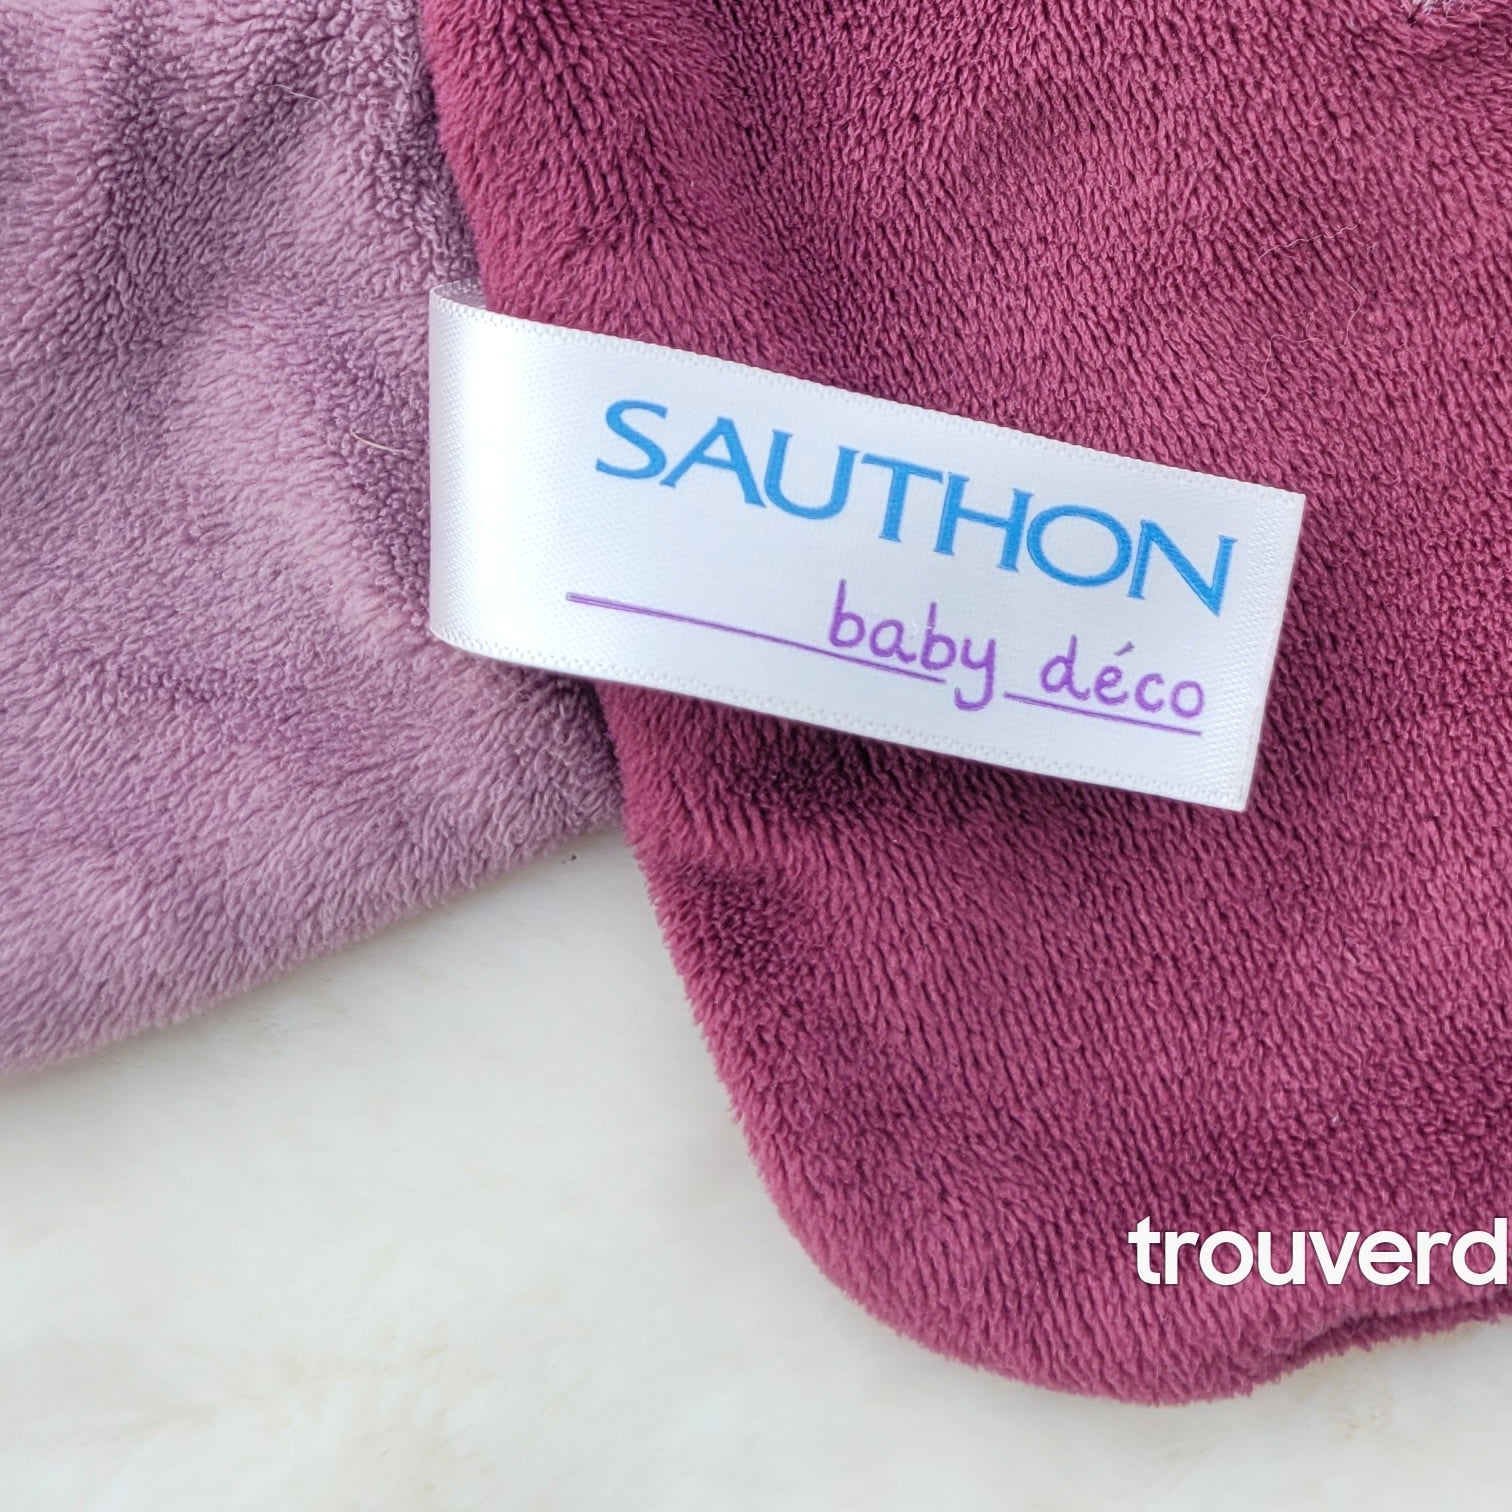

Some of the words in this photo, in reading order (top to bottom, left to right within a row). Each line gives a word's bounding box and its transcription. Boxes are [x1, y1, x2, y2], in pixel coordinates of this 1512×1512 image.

[593, 397, 1239, 617] SAUTHON
[828, 579, 998, 712] baby
[1039, 634, 1206, 720] déco
